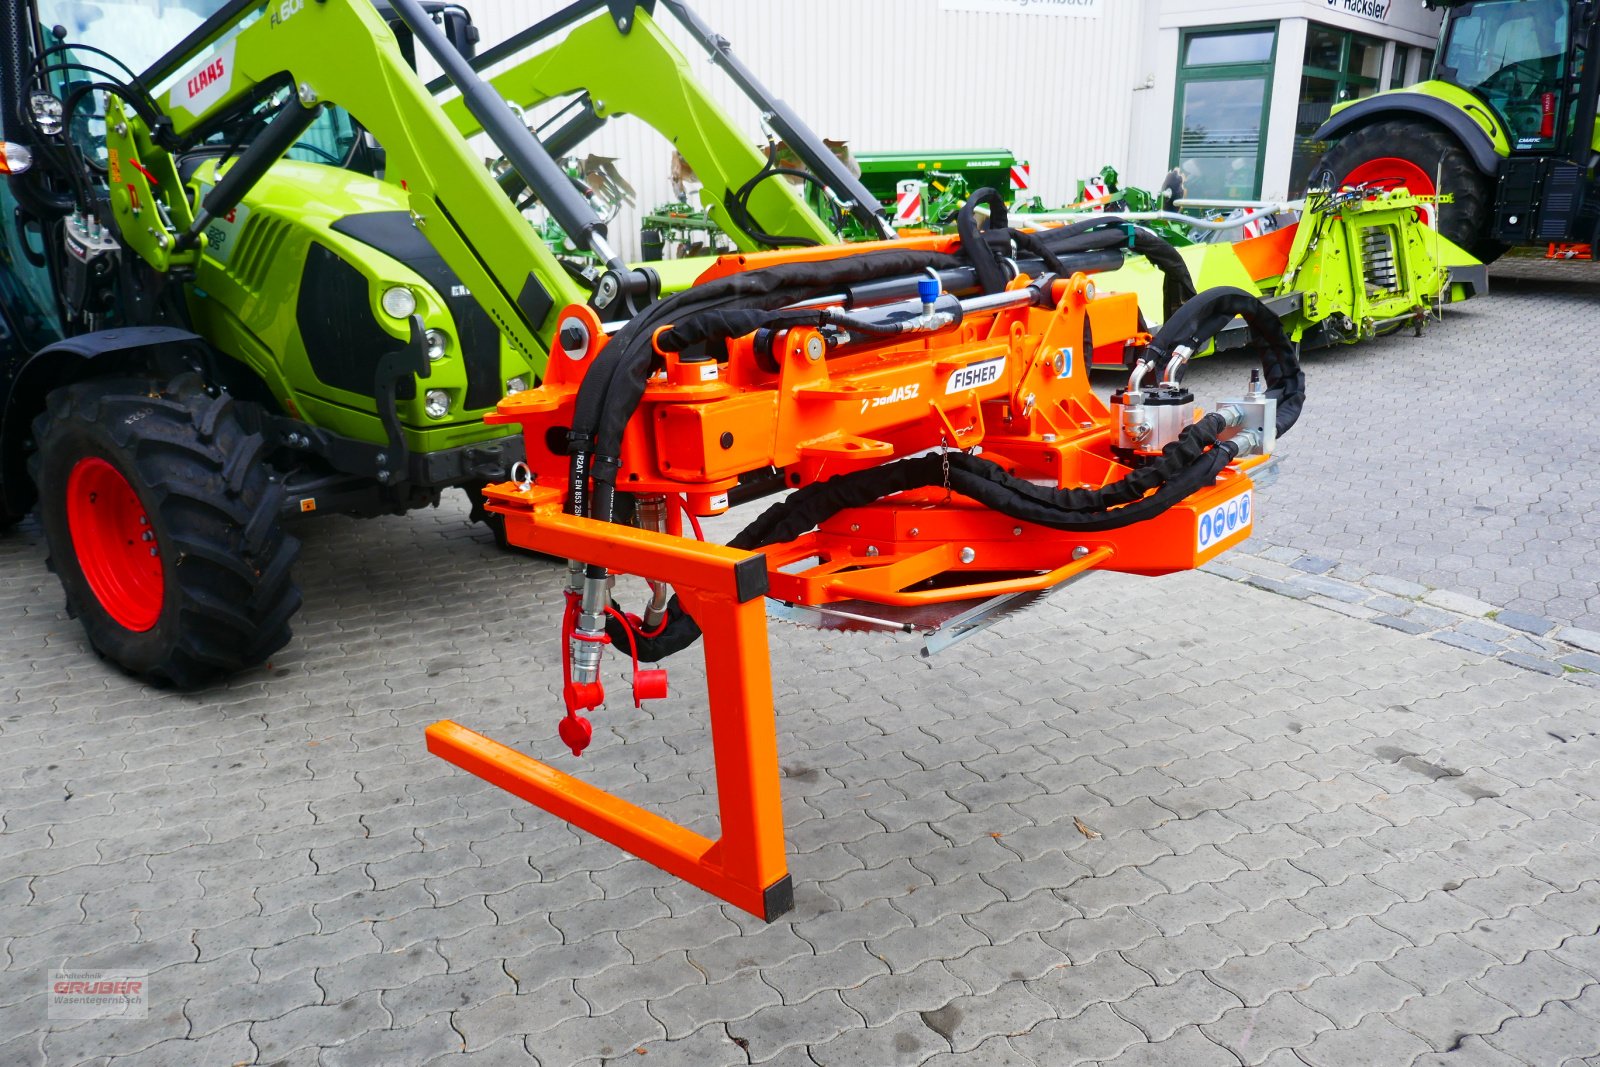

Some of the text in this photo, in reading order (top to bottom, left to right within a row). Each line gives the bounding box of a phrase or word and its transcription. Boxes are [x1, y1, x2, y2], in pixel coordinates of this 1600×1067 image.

[188, 57, 225, 98] CLAAS
[954, 364, 996, 389] FISHER
[576, 455, 584, 474] R2AT
[575, 480, 582, 489] EN
